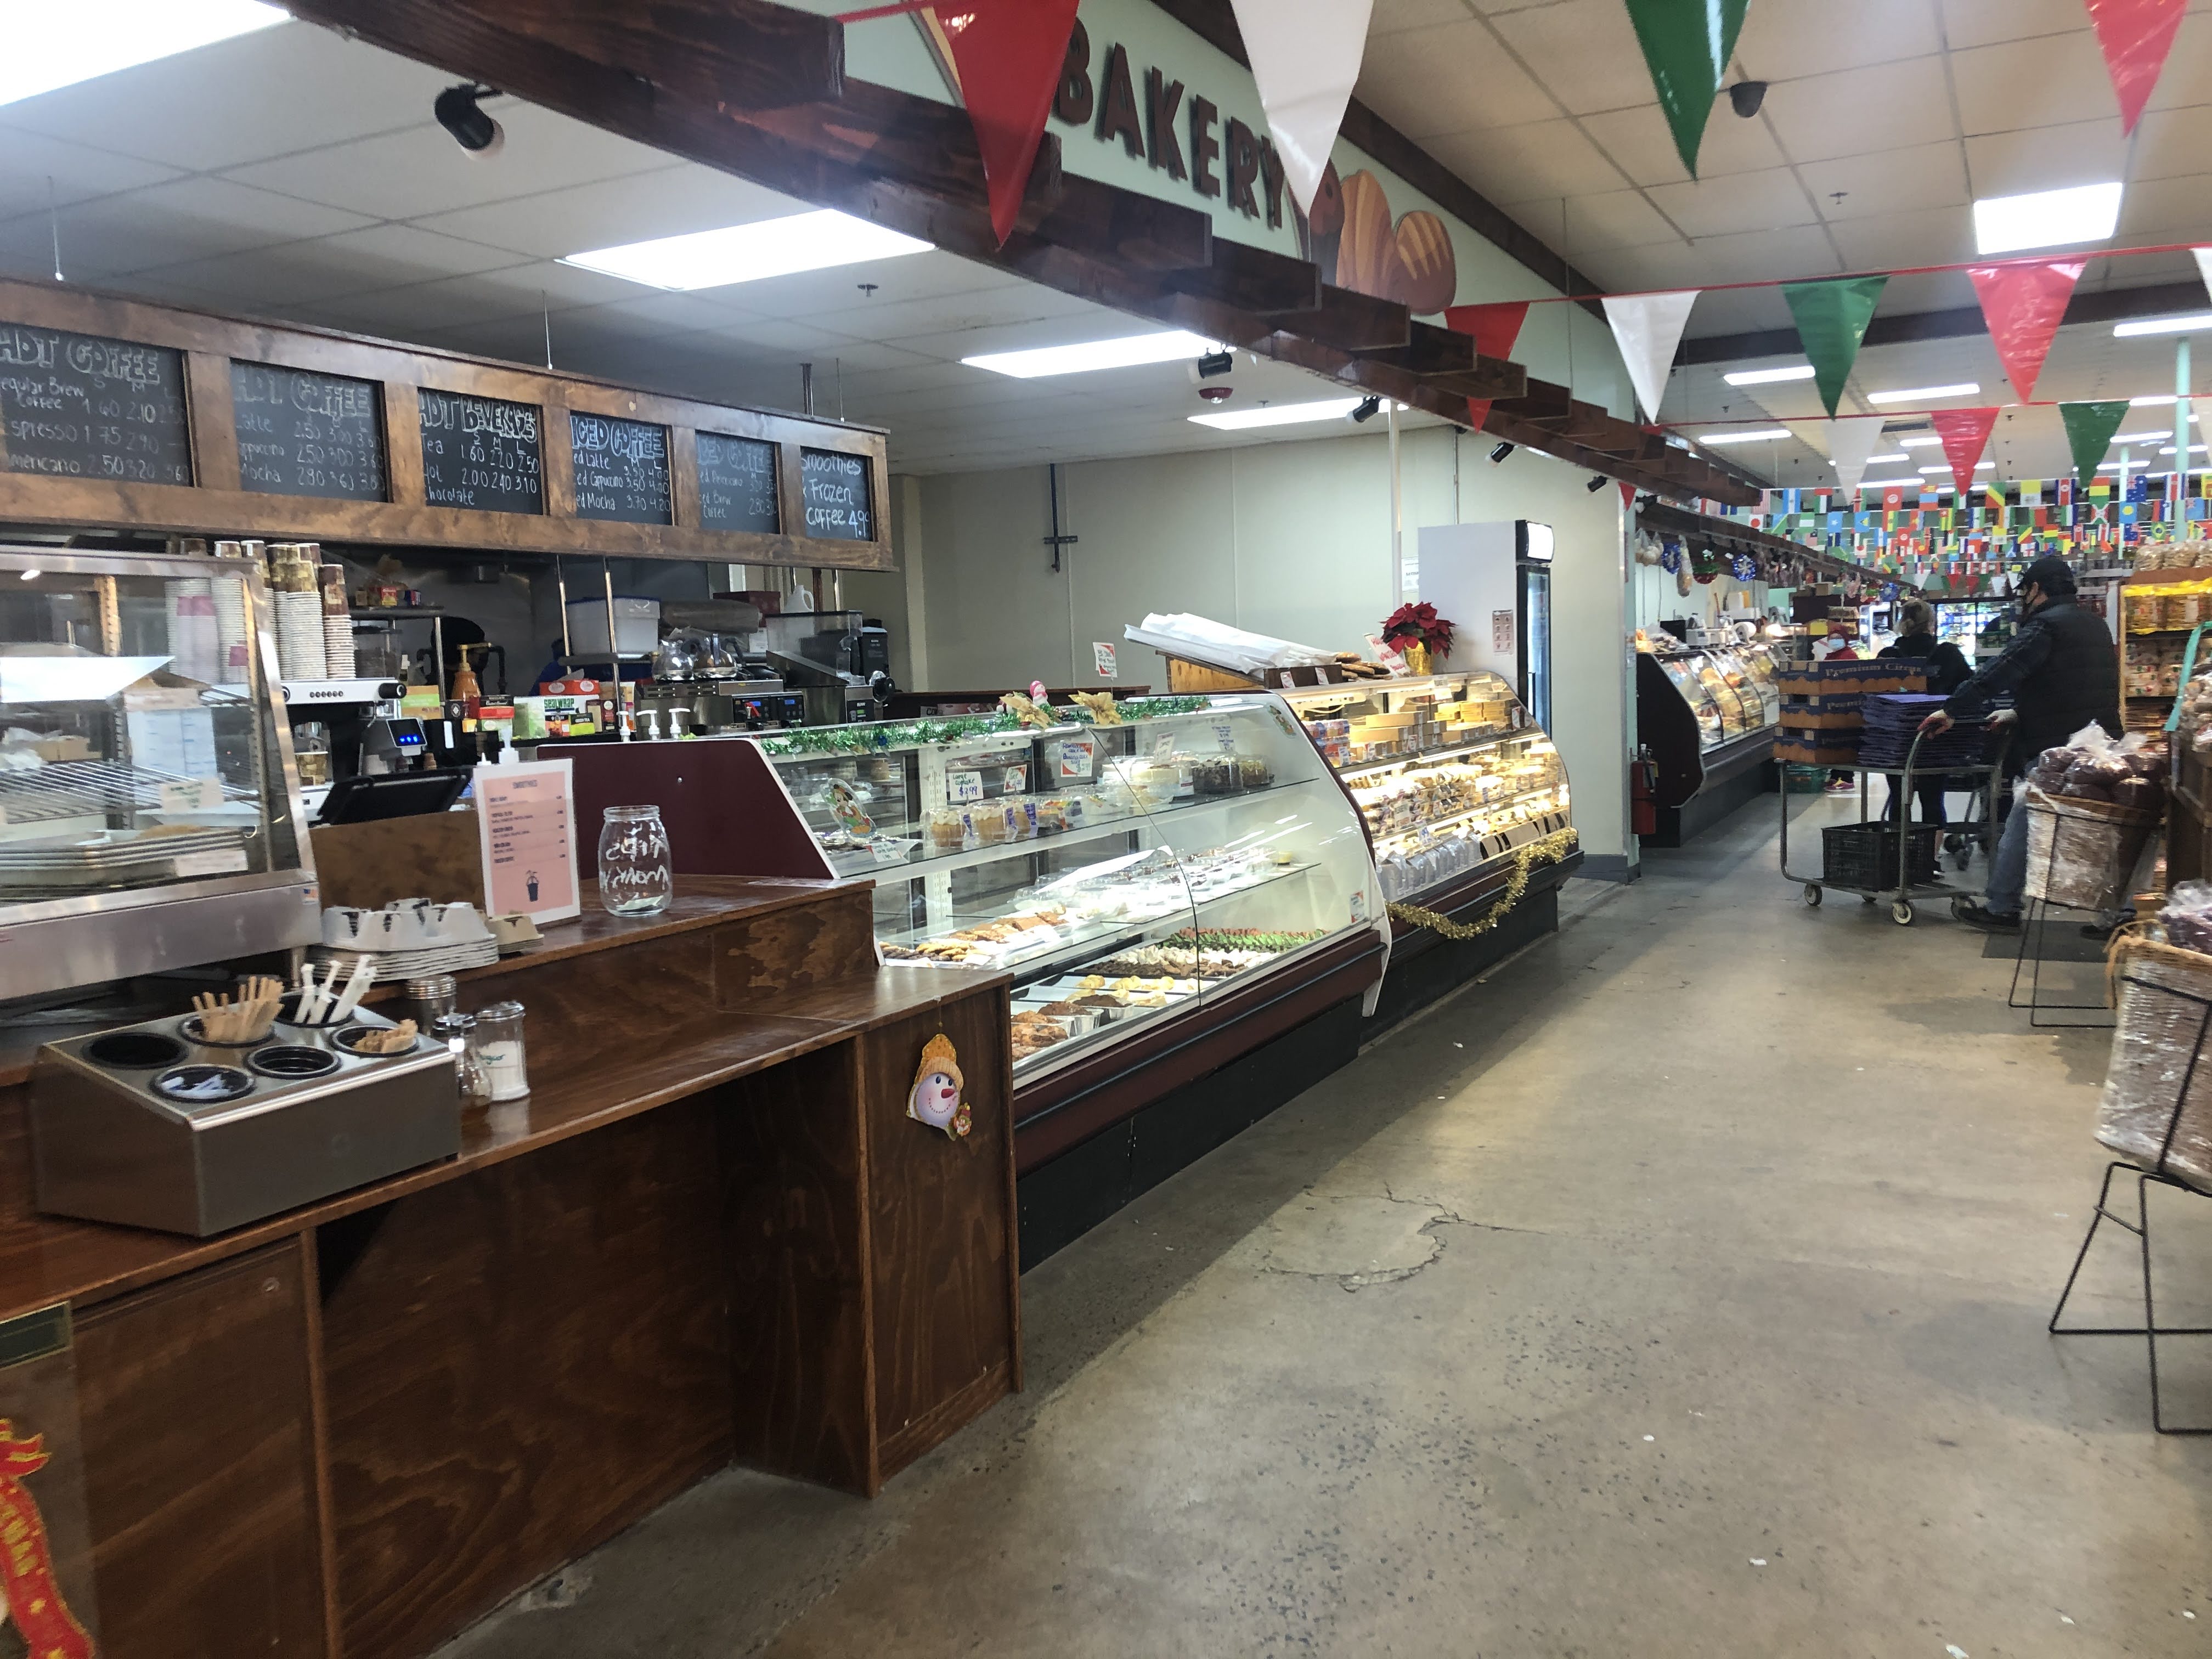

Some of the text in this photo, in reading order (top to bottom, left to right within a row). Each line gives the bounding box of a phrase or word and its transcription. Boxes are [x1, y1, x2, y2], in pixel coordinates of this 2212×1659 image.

[1056, 17, 1285, 230] BAKERY
[11, 420, 78, 442] spresso
[472, 431, 526, 454] S M L
[7, 453, 81, 473] mericano
[585, 452, 611, 470] Latte
[631, 457, 662, 470] M L
[801, 453, 861, 476] Smoothies
[590, 470, 624, 492] Cappuccino
[809, 478, 855, 506] Frozen
[428, 487, 475, 506] hocolate
[587, 492, 616, 511] Mocha
